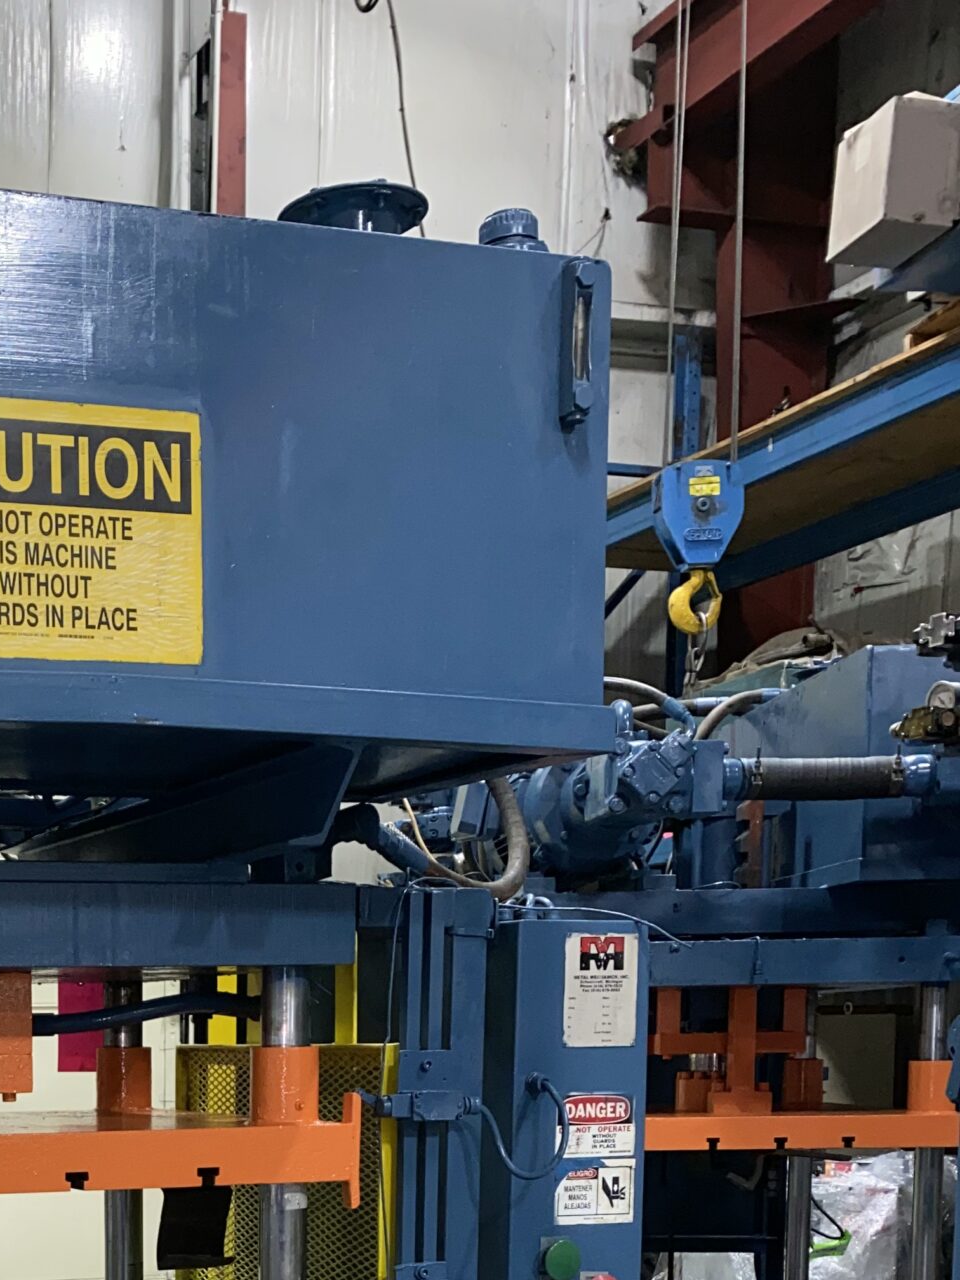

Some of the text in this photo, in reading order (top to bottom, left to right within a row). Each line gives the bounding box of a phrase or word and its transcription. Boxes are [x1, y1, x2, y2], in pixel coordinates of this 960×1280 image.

[39, 512, 133, 541] OPERATE
[24, 542, 117, 570] MACHINE
[0, 571, 92, 599] WITHOUT
[45, 604, 64, 628] IN
[71, 606, 138, 632] PLACE
[566, 1102, 626, 1119] DANGER
[575, 1126, 591, 1134] NOT
[597, 1125, 631, 1133] OPERATE
[564, 1184, 592, 1192] MANTENER
[568, 1193, 587, 1201] MANOS
[564, 1202, 591, 1210] ALEJADAS
